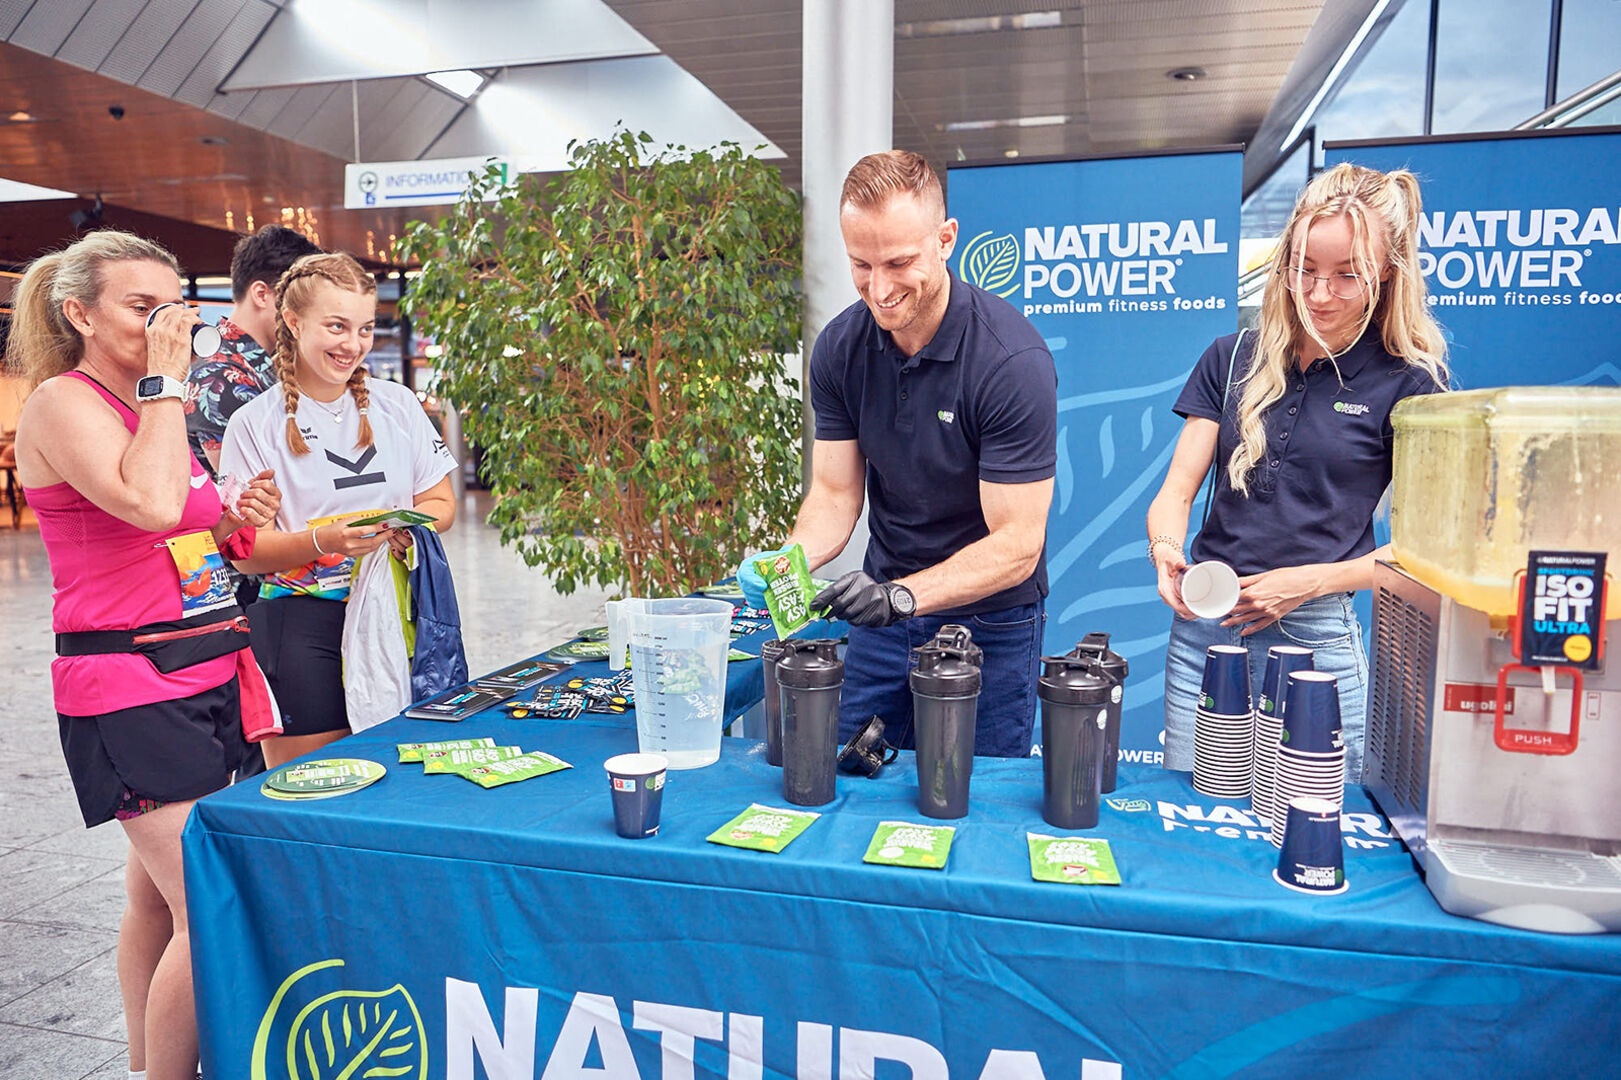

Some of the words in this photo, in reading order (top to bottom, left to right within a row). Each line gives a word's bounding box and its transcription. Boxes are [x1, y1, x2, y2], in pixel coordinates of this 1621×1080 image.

[385, 170, 478, 188] INFORMATIO
[1416, 207, 1621, 248] NATURA
[1024, 218, 1228, 261] NATURAL
[1024, 300, 1102, 316] premium
[1108, 298, 1168, 312] fitness
[1173, 296, 1226, 311] foods
[1424, 291, 1496, 306] emium
[1504, 291, 1572, 306] fitness
[1535, 574, 1595, 599] ISO
[1534, 596, 1593, 622] FIT
[1534, 620, 1591, 635] ULTRA
[1460, 700, 1512, 712] ugolii
[1515, 734, 1552, 745] PUSH
[1117, 748, 1165, 765] WER
[1294, 873, 1336, 887] NATURAL
[446, 976, 1123, 1080] NATUR
